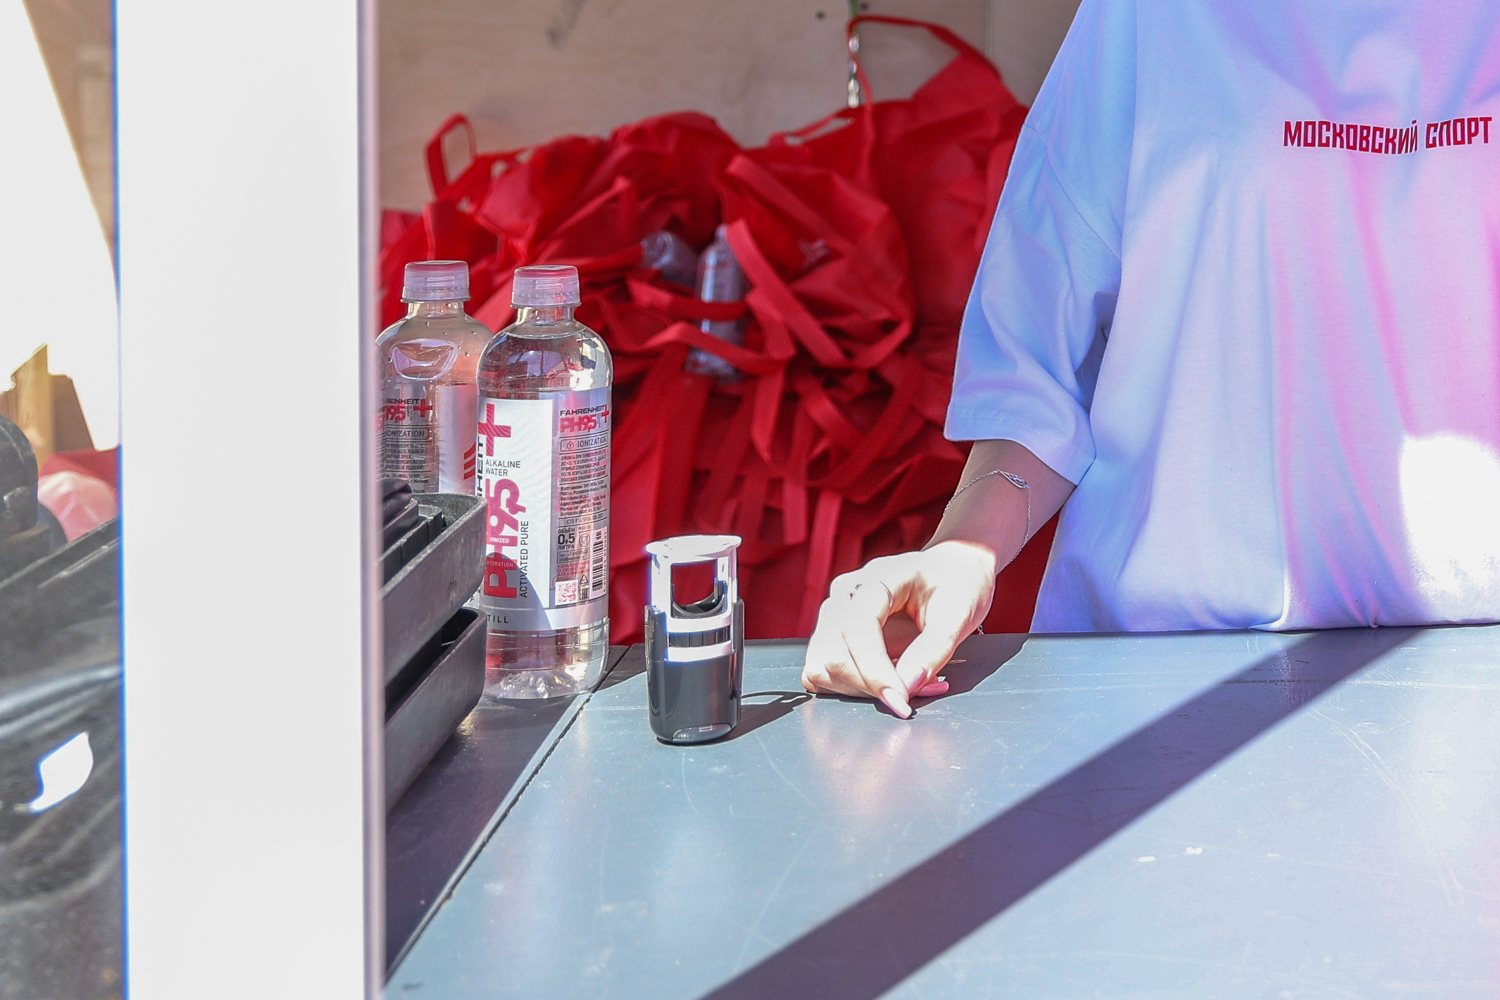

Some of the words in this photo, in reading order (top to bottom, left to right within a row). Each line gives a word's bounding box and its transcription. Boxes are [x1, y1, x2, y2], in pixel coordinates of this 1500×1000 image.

[1284, 119, 1418, 155] МОСКОВСКИЙ
[1425, 116, 1493, 149] СПОРТ
[577, 436, 607, 448] IONIZATION
[485, 459, 521, 469] ALKALINE
[485, 468, 509, 477] WATER
[520, 520, 529, 546] PURE
[557, 533, 575, 545] 0,5
[490, 536, 510, 544] IONIZED
[519, 548, 529, 598] ACTIVATED
